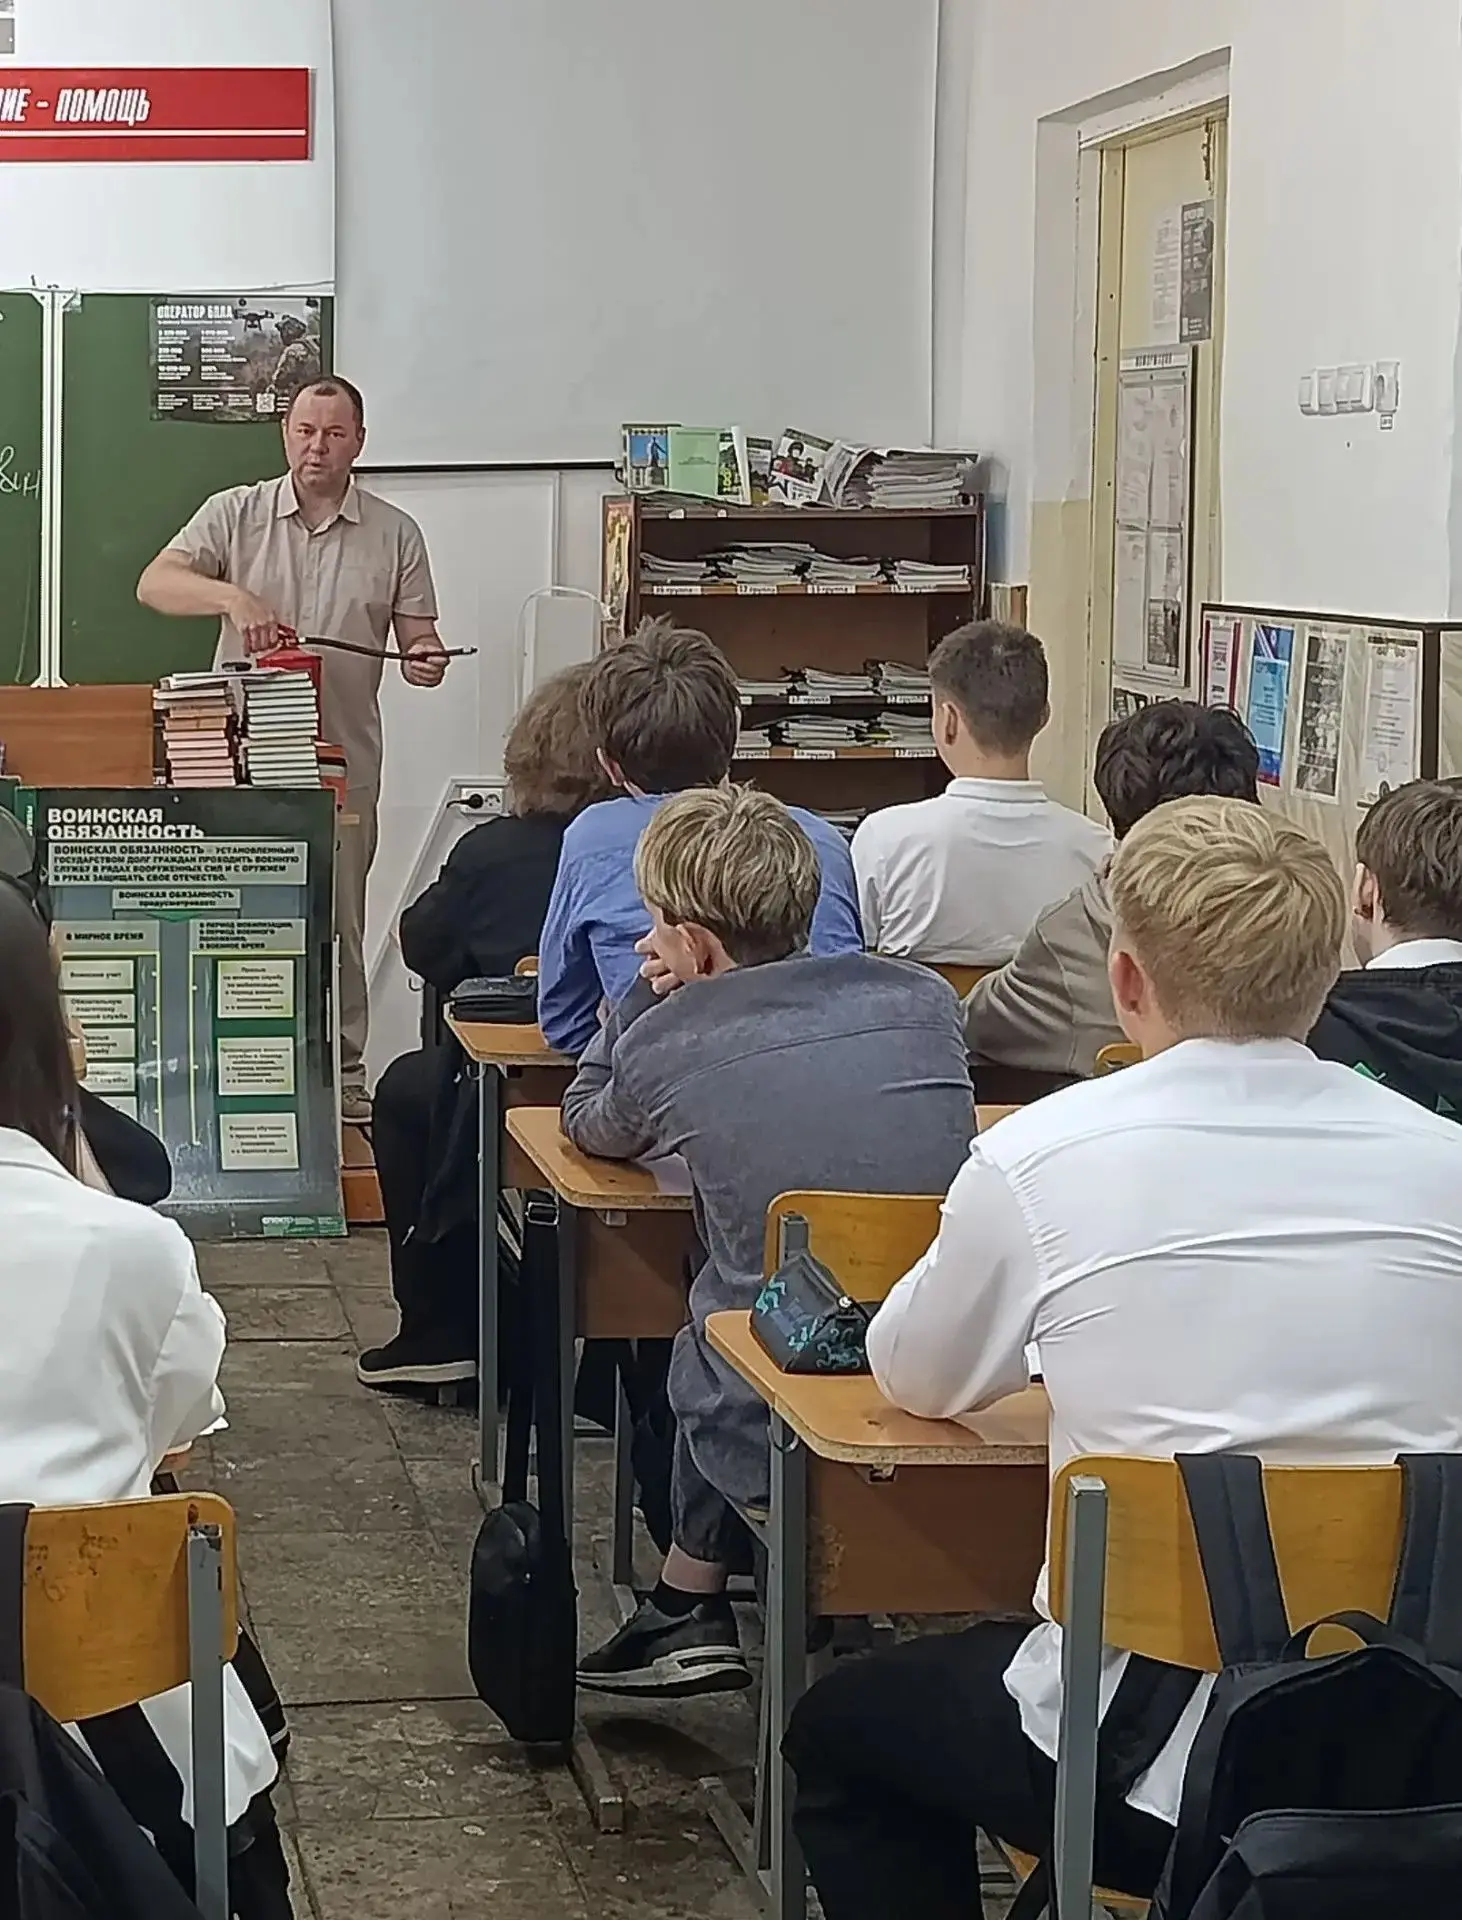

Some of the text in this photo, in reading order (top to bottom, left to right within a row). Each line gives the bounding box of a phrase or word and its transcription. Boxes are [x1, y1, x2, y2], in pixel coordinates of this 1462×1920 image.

[55, 88, 151, 126] ПОМОЩЬ
[157, 305, 206, 319] ОПЕРАТОР
[48, 808, 163, 823] ВОИНСКАЯ
[47, 825, 204, 840] ОБЯЗАННОСТЬ
[54, 845, 117, 855] ВОИНСКАЯ
[119, 845, 205, 855] ОБЯЗАННОСТЬ
[119, 891, 167, 899] ВОИНСКАЯ
